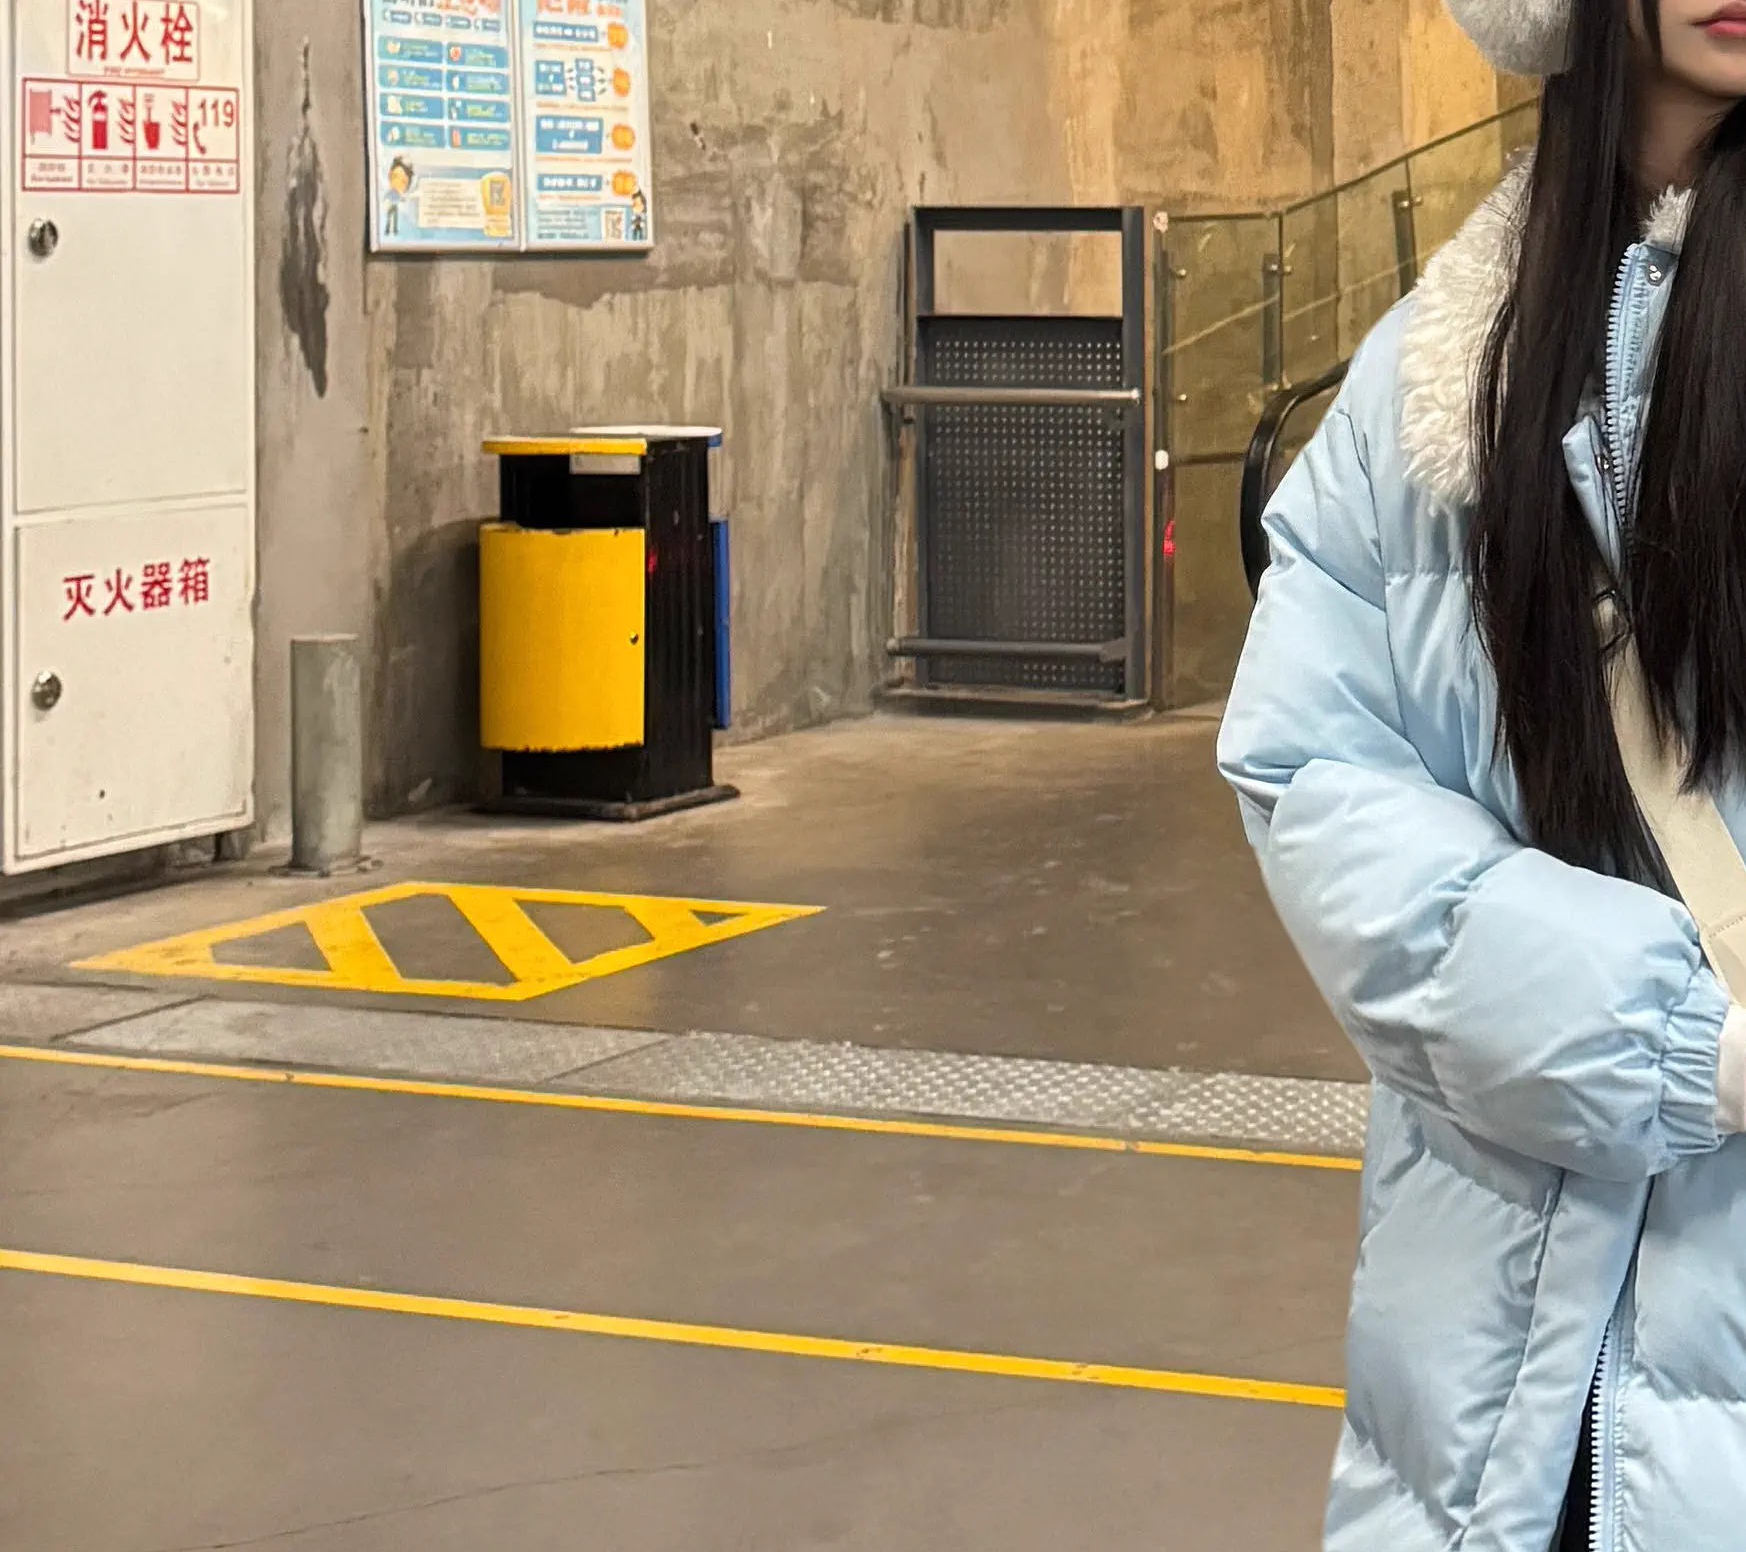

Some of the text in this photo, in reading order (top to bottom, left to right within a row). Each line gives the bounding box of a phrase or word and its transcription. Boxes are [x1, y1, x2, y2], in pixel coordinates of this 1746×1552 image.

[197, 97, 234, 128] 119
[62, 556, 210, 621] 灭火器箱
